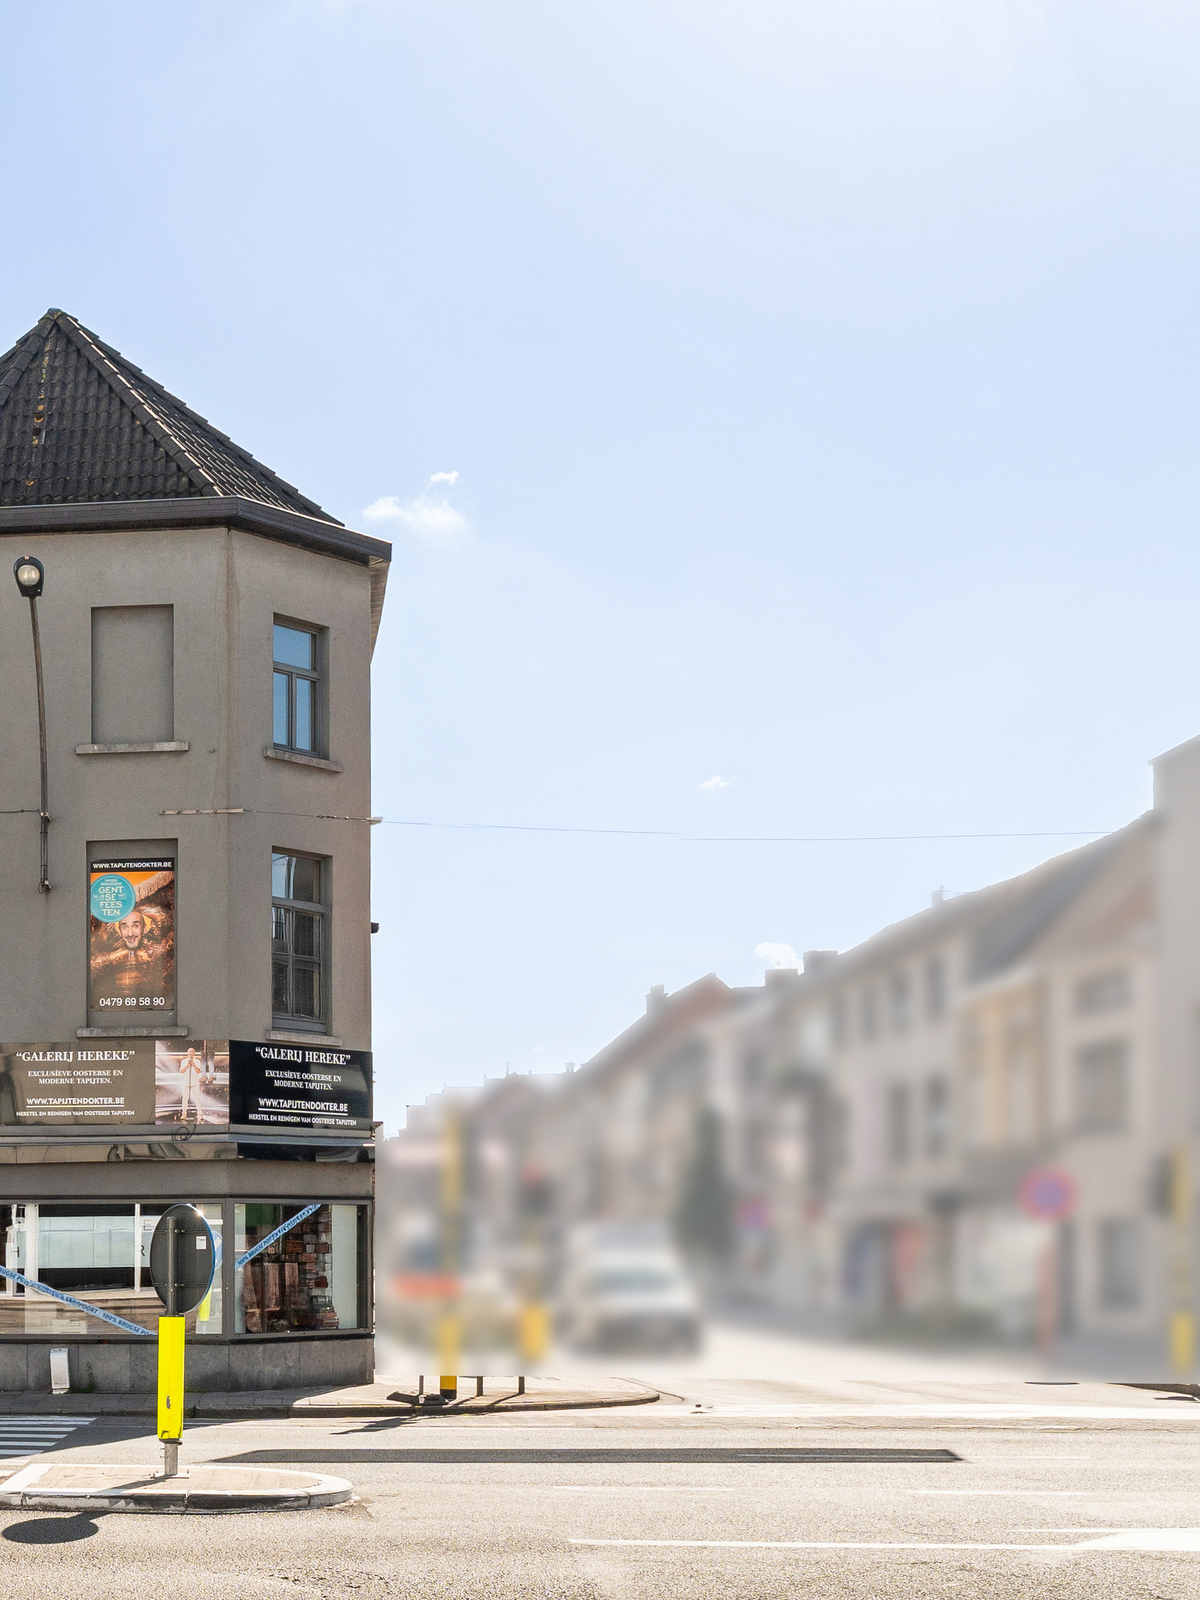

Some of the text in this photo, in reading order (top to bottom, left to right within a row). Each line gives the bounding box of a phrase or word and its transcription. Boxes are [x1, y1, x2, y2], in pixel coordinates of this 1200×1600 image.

[99, 997, 165, 1007] 0479 69 58 90
[302, 1073, 332, 1081] OOSTERSE
[274, 1080, 304, 1088] MODERNE
[26, 1097, 125, 1105] WWW.TAPIJTENDOKTER.BE
[258, 1098, 348, 1112] WWW.TAPIJTENDOKTER.BE
[102, 1312, 117, 1324] 100%
[118, 1318, 140, 1333] BRUGSE
